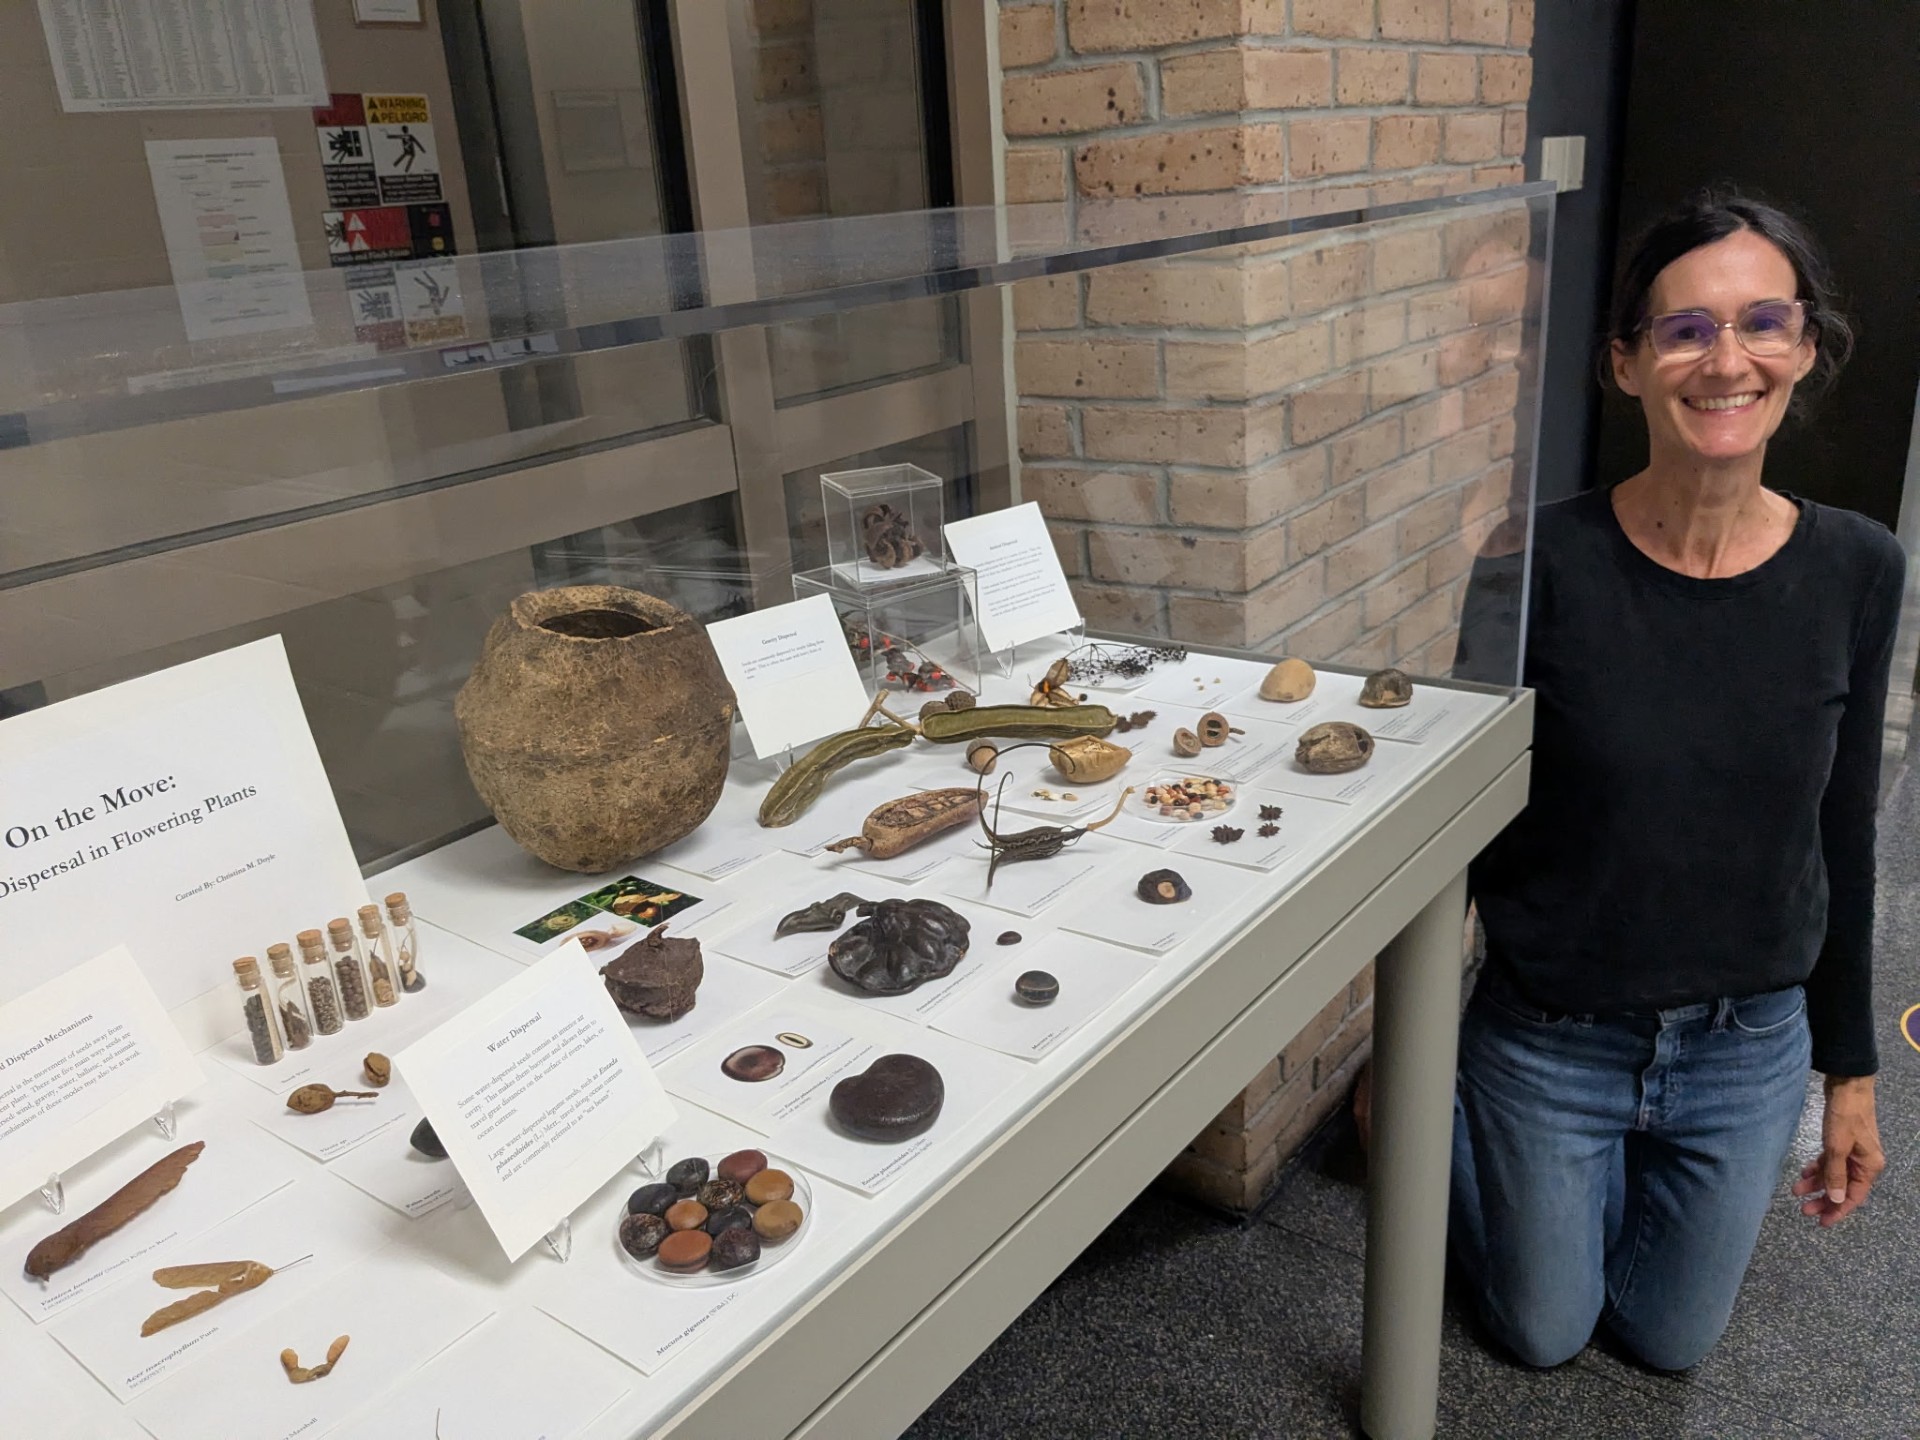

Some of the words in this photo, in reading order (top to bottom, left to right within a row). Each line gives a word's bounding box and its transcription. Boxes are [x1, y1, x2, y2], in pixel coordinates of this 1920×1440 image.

[379, 97, 426, 109] WARNING
[383, 111, 428, 123] PELIGRO
[5, 825, 50, 848] On
[55, 807, 95, 831] the
[100, 776, 176, 813] Move:
[89, 845, 110, 860] in
[111, 809, 203, 851] Flowering
[204, 786, 256, 813] Plants
[175, 885, 203, 901] Curated
[203, 881, 215, 889] By:
[216, 868, 246, 883] Christina
[246, 862, 256, 870] M.
[256, 854, 275, 865] Doyle
[5, 1040, 44, 1066] Dispersal
[44, 1014, 93, 1044] Mechanisms
[22, 1077, 33, 1086] the
[34, 1057, 67, 1079] movement
[67, 1050, 75, 1059] of
[76, 1042, 92, 1054] seeds
[92, 1034, 107, 1044] away
[107, 1025, 123, 1036] from
[487, 1036, 510, 1052] Water
[509, 1012, 542, 1038] Dispersal
[10, 1094, 29, 1108] plant.
[30, 1080, 50, 1093] There
[51, 1073, 61, 1082] are
[61, 1066, 74, 1075] five
[74, 1057, 90, 1068] main
[90, 1048, 105, 1058] ways
[105, 1037, 121, 1049] seeds
[121, 1032, 131, 1042] are
[16, 1102, 35, 1115] wind,
[34, 1089, 58, 1107] gravity,
[58, 1078, 78, 1090] water,
[76, 1063, 102, 1078] ballistic,
[102, 1053, 114, 1064] and
[114, 1041, 136, 1057] animals
[37, 1106, 45, 1116] of
[45, 1098, 62, 1111] these
[63, 1086, 83, 1100] modes
[84, 1078, 97, 1087] may
[97, 1070, 110, 1079] also
[457, 1095, 475, 1109] Some
[475, 1062, 517, 1096] water-dispersed
[517, 1053, 531, 1066] seeds
[532, 1039, 551, 1055] contain
[465, 1104, 483, 1119] cavity.
[484, 1093, 498, 1103] This
[498, 1080, 515, 1094] makes
[515, 1069, 530, 1081] them
[528, 1053, 551, 1071] buoyant
[551, 1044, 562, 1055] and
[561, 1034, 578, 1047] allows
[577, 1024, 591, 1036] them
[470, 1113, 487, 1129] travel
[487, 1104, 502, 1119] great
[502, 1086, 526, 1106] distances
[526, 1080, 535, 1088] on
[534, 1073, 543, 1082] the
[543, 1059, 562, 1075] surface
[561, 1052, 568, 1061] of
[568, 1044, 585, 1056] rivers,
[583, 1034, 599, 1045] lakes,
[477, 1125, 495, 1140] ocean
[488, 1146, 505, 1161] Large
[505, 1113, 547, 1147] water-dispersed
[545, 1100, 565, 1116] legume
[580, 1078, 593, 1090] such
[599, 1058, 618, 1075] Entada
[496, 1139, 533, 1173] phaseoloides
[560, 1104, 575, 1120] travel
[575, 1096, 590, 1108] along
[589, 1084, 604, 1097] ocean
[603, 1069, 623, 1085] currents
[502, 1169, 513, 1182] and
[513, 1163, 523, 1173] are
[522, 1141, 550, 1165] commonly
[550, 1122, 571, 1143] referred
[126, 1371, 143, 1384] Acer
[146, 1338, 199, 1372] macrophyllum
[656, 1335, 683, 1356] Mucuna
[683, 1315, 710, 1336] gigantea
